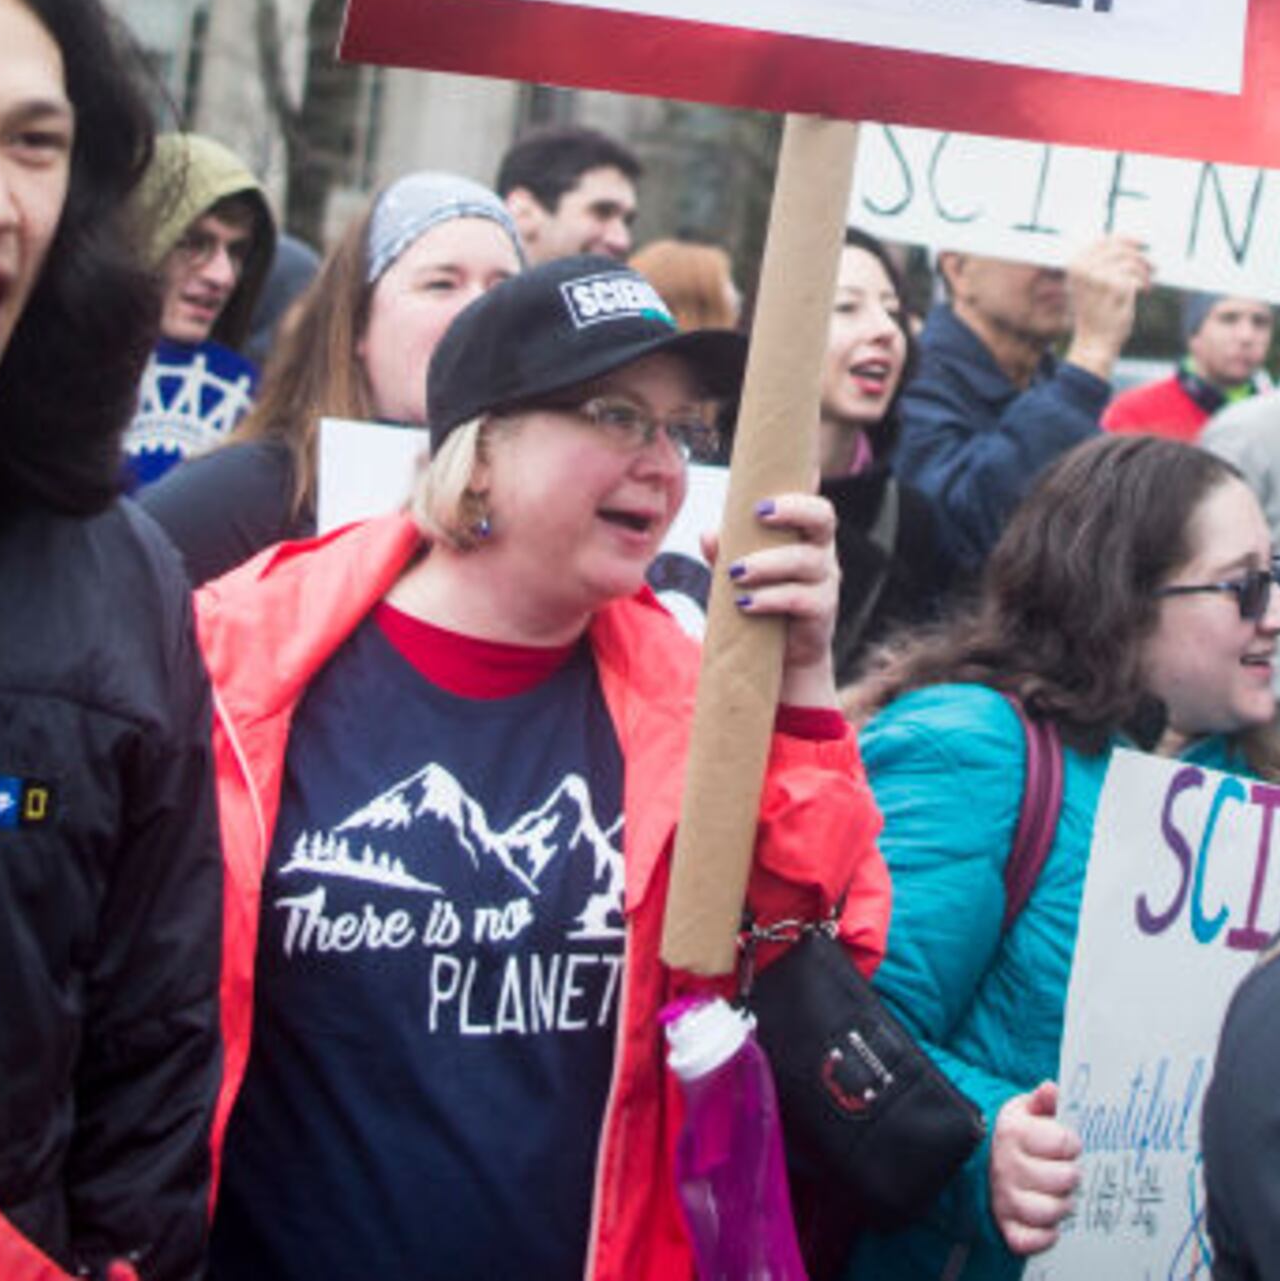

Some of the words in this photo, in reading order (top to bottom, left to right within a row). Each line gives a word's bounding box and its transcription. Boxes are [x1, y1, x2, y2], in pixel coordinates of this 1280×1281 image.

[274, 886, 417, 958] There
[422, 900, 461, 948] is
[471, 897, 534, 945] no
[428, 952, 625, 1035] PLANET
